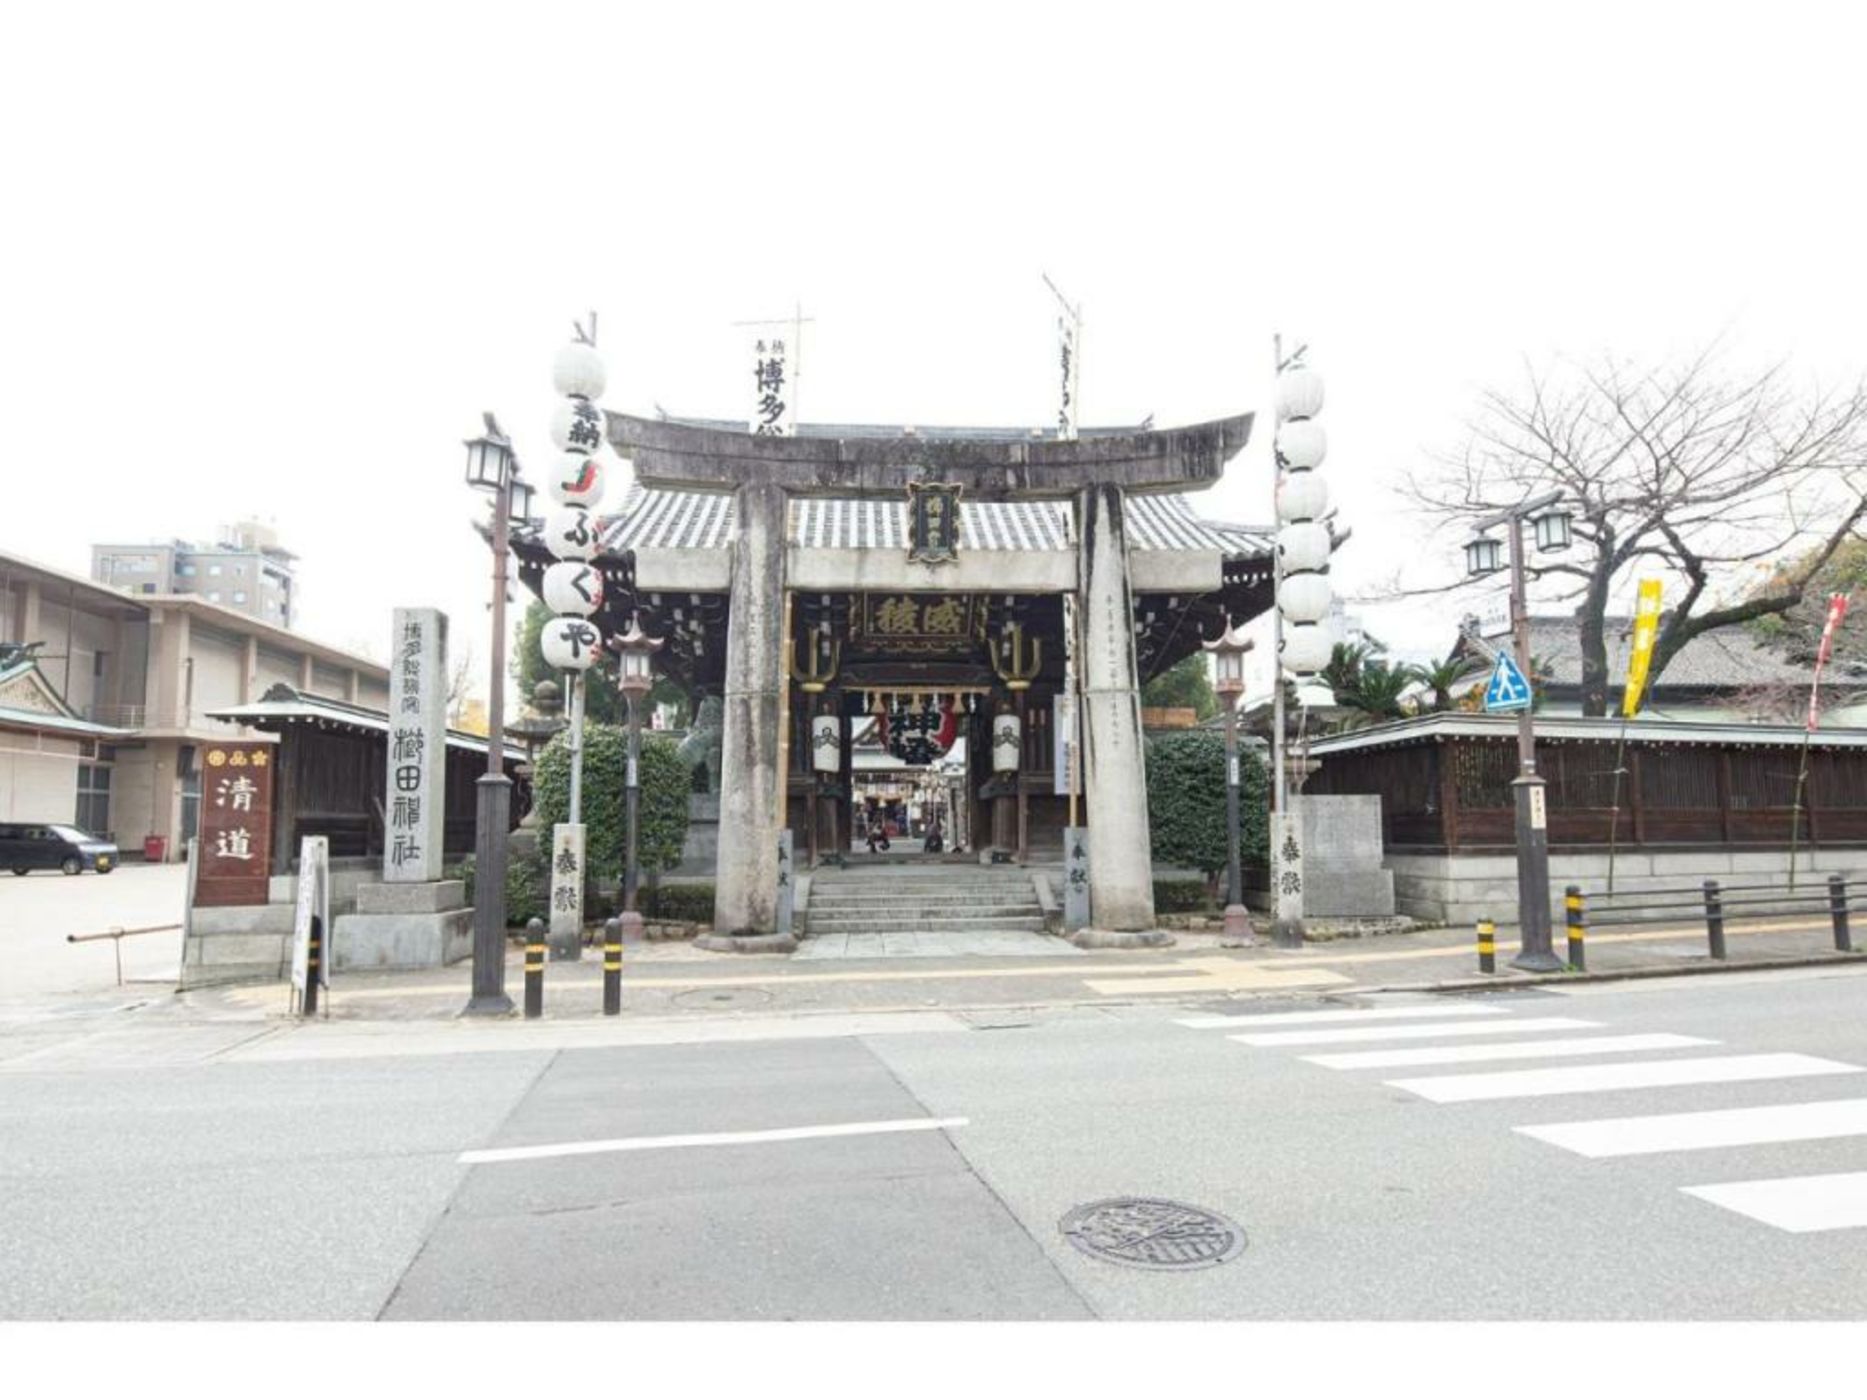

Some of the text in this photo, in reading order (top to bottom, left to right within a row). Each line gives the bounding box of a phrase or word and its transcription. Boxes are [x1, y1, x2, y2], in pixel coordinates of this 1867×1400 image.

[569, 403, 601, 450] 奉納
[560, 512, 600, 659] ふくや
[215, 775, 258, 860] 清道
[391, 727, 425, 866] 櫛田神社
